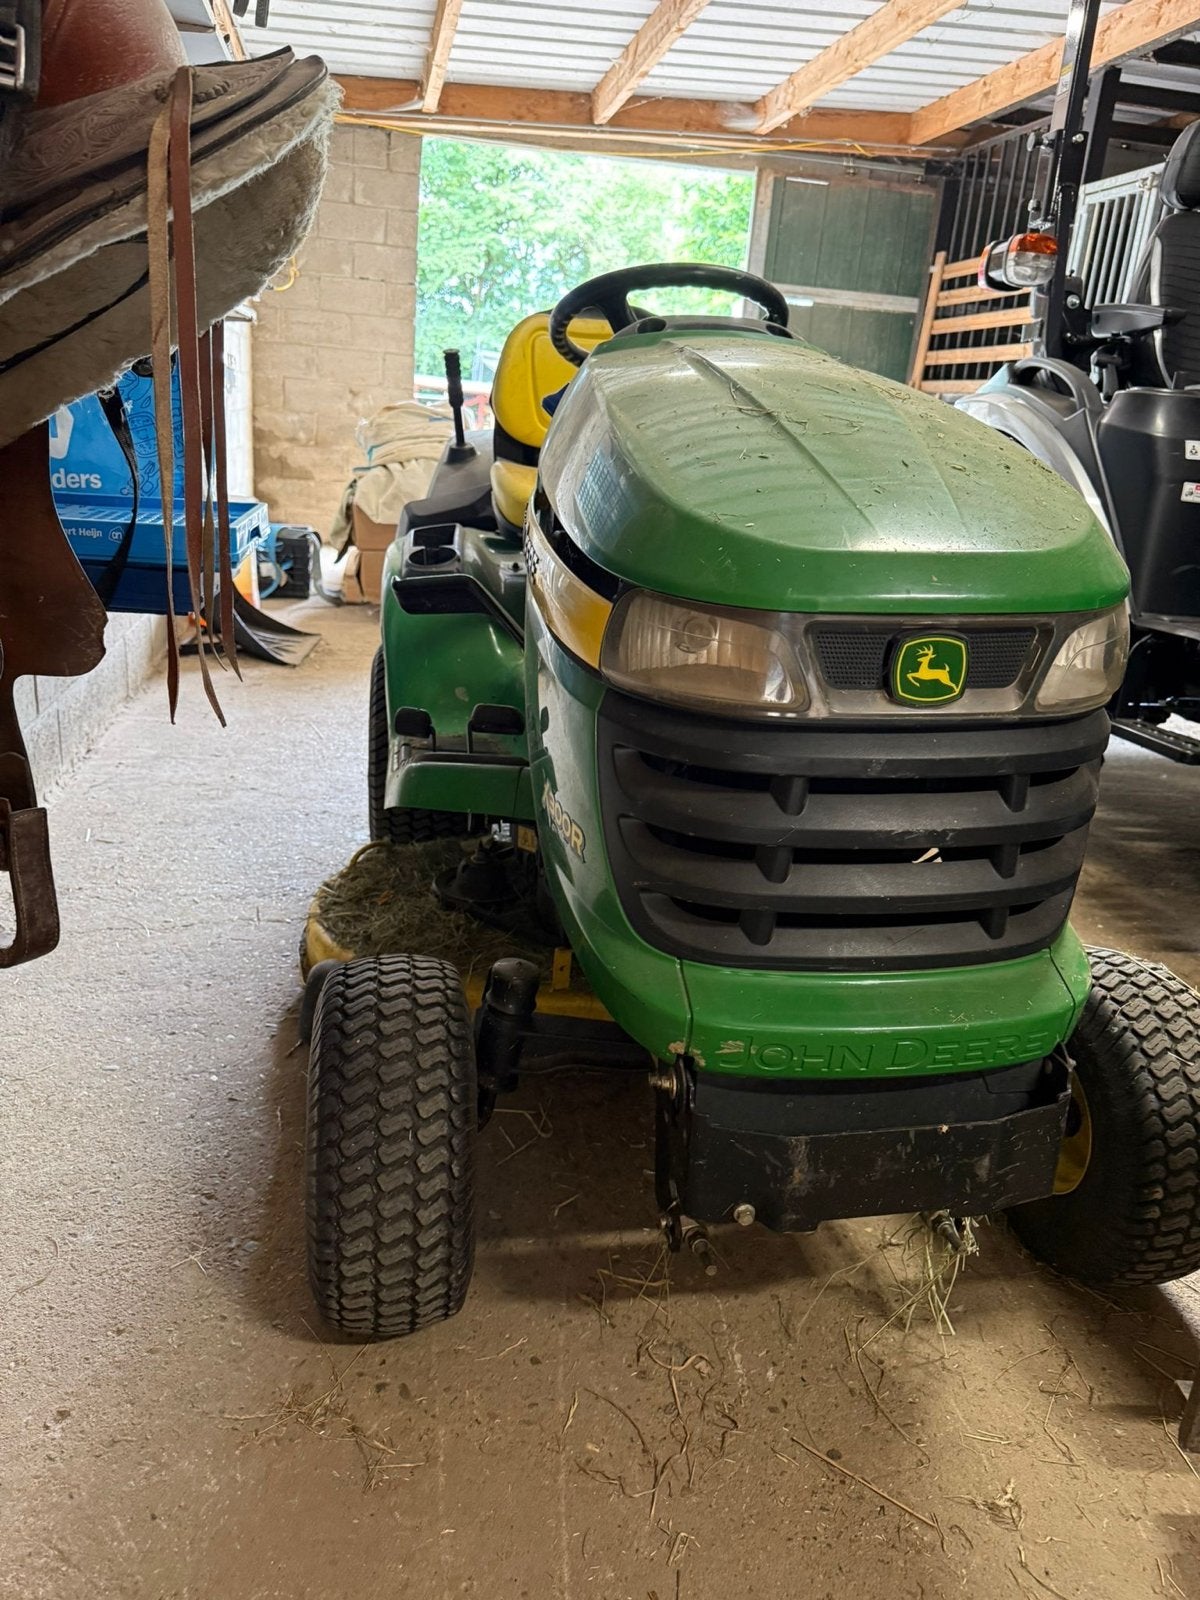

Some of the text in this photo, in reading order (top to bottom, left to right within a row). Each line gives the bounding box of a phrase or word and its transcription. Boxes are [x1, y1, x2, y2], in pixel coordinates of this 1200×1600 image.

[52, 468, 102, 489] ders
[78, 527, 103, 539] Heijn
[719, 1031, 1049, 1071] JOHN DEERE
